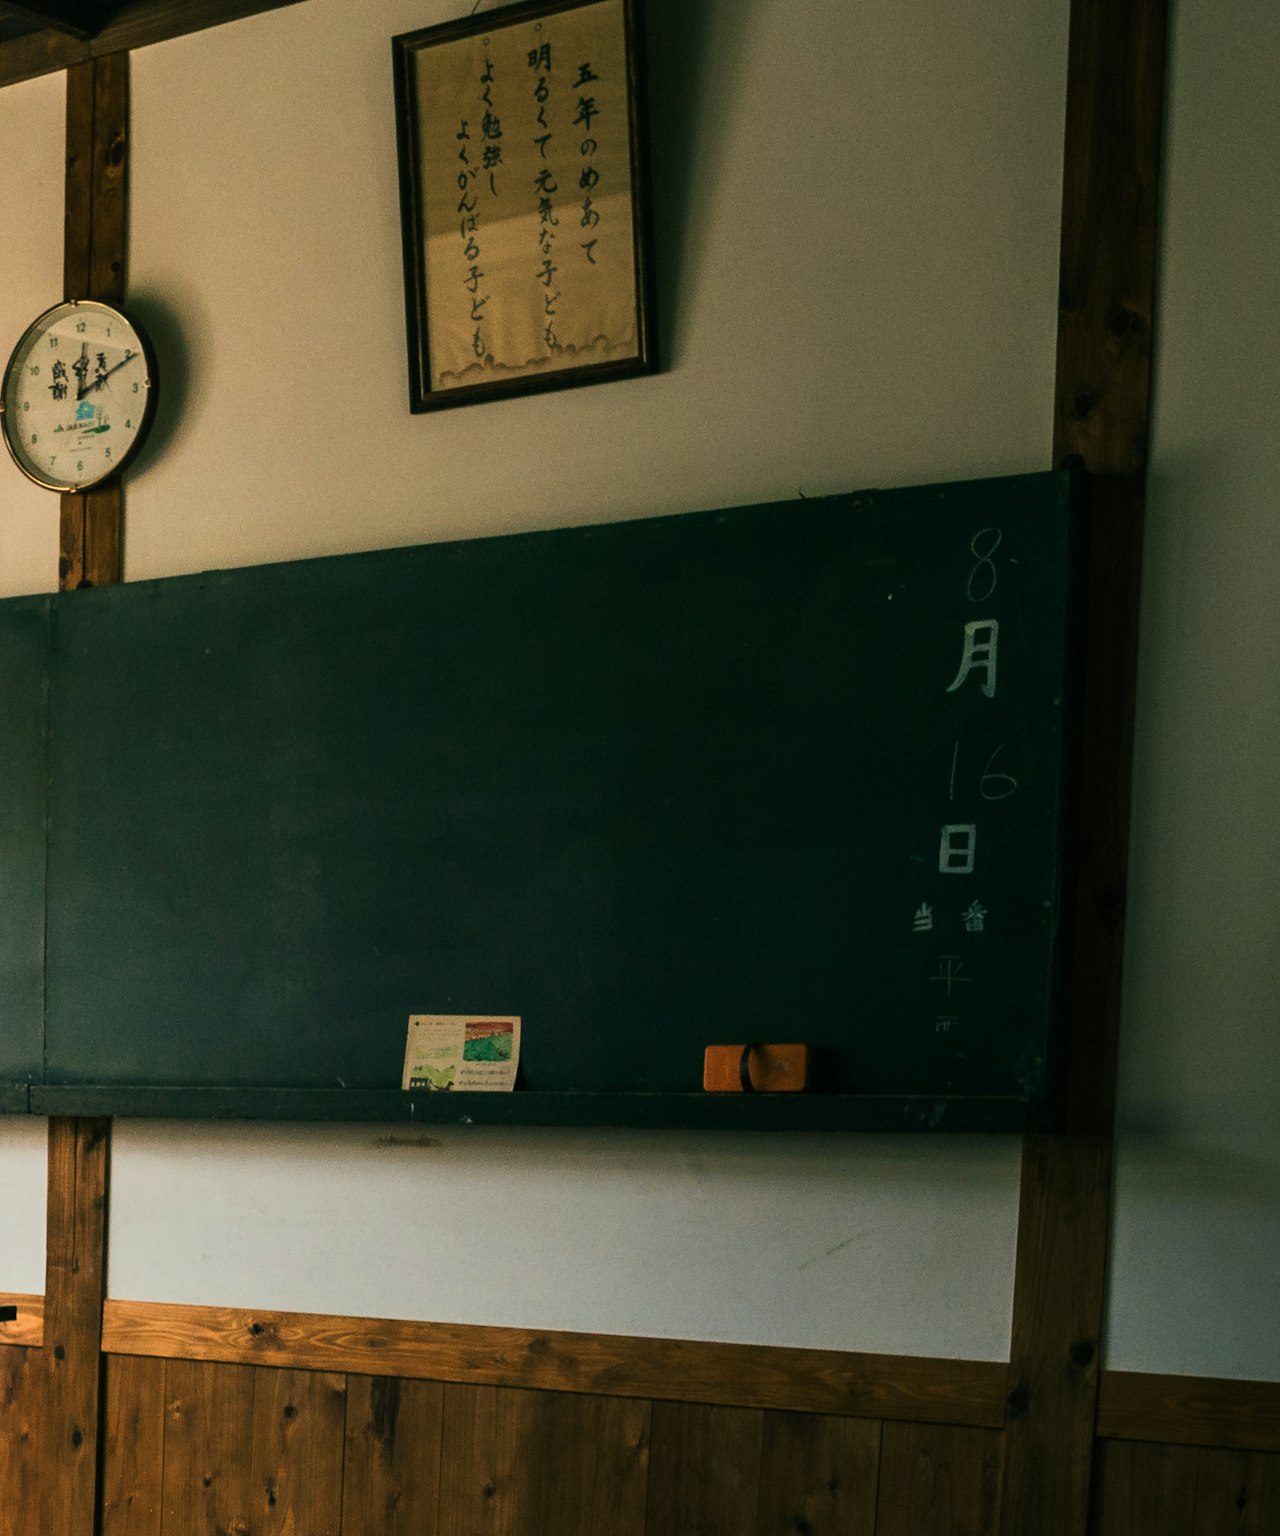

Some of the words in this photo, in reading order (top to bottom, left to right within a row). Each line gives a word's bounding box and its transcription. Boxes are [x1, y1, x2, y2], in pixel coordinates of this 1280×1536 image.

[479, 58, 504, 197] よく勉強し
[571, 61, 601, 266] 五年のめあて
[455, 118, 491, 357] よくがんばる子ども
[76, 322, 87, 334] 12
[106, 327, 111, 338] 1
[49, 337, 59, 348] 11
[30, 365, 40, 376] 10
[132, 383, 139, 394] 3
[23, 401, 30, 412] 9
[124, 419, 132, 430] 4
[31, 433, 38, 444] 8
[105, 448, 111, 458] 5
[49, 455, 57, 466] 7
[77, 460, 84, 471] 6
[912, 899, 988, 933] 当番
